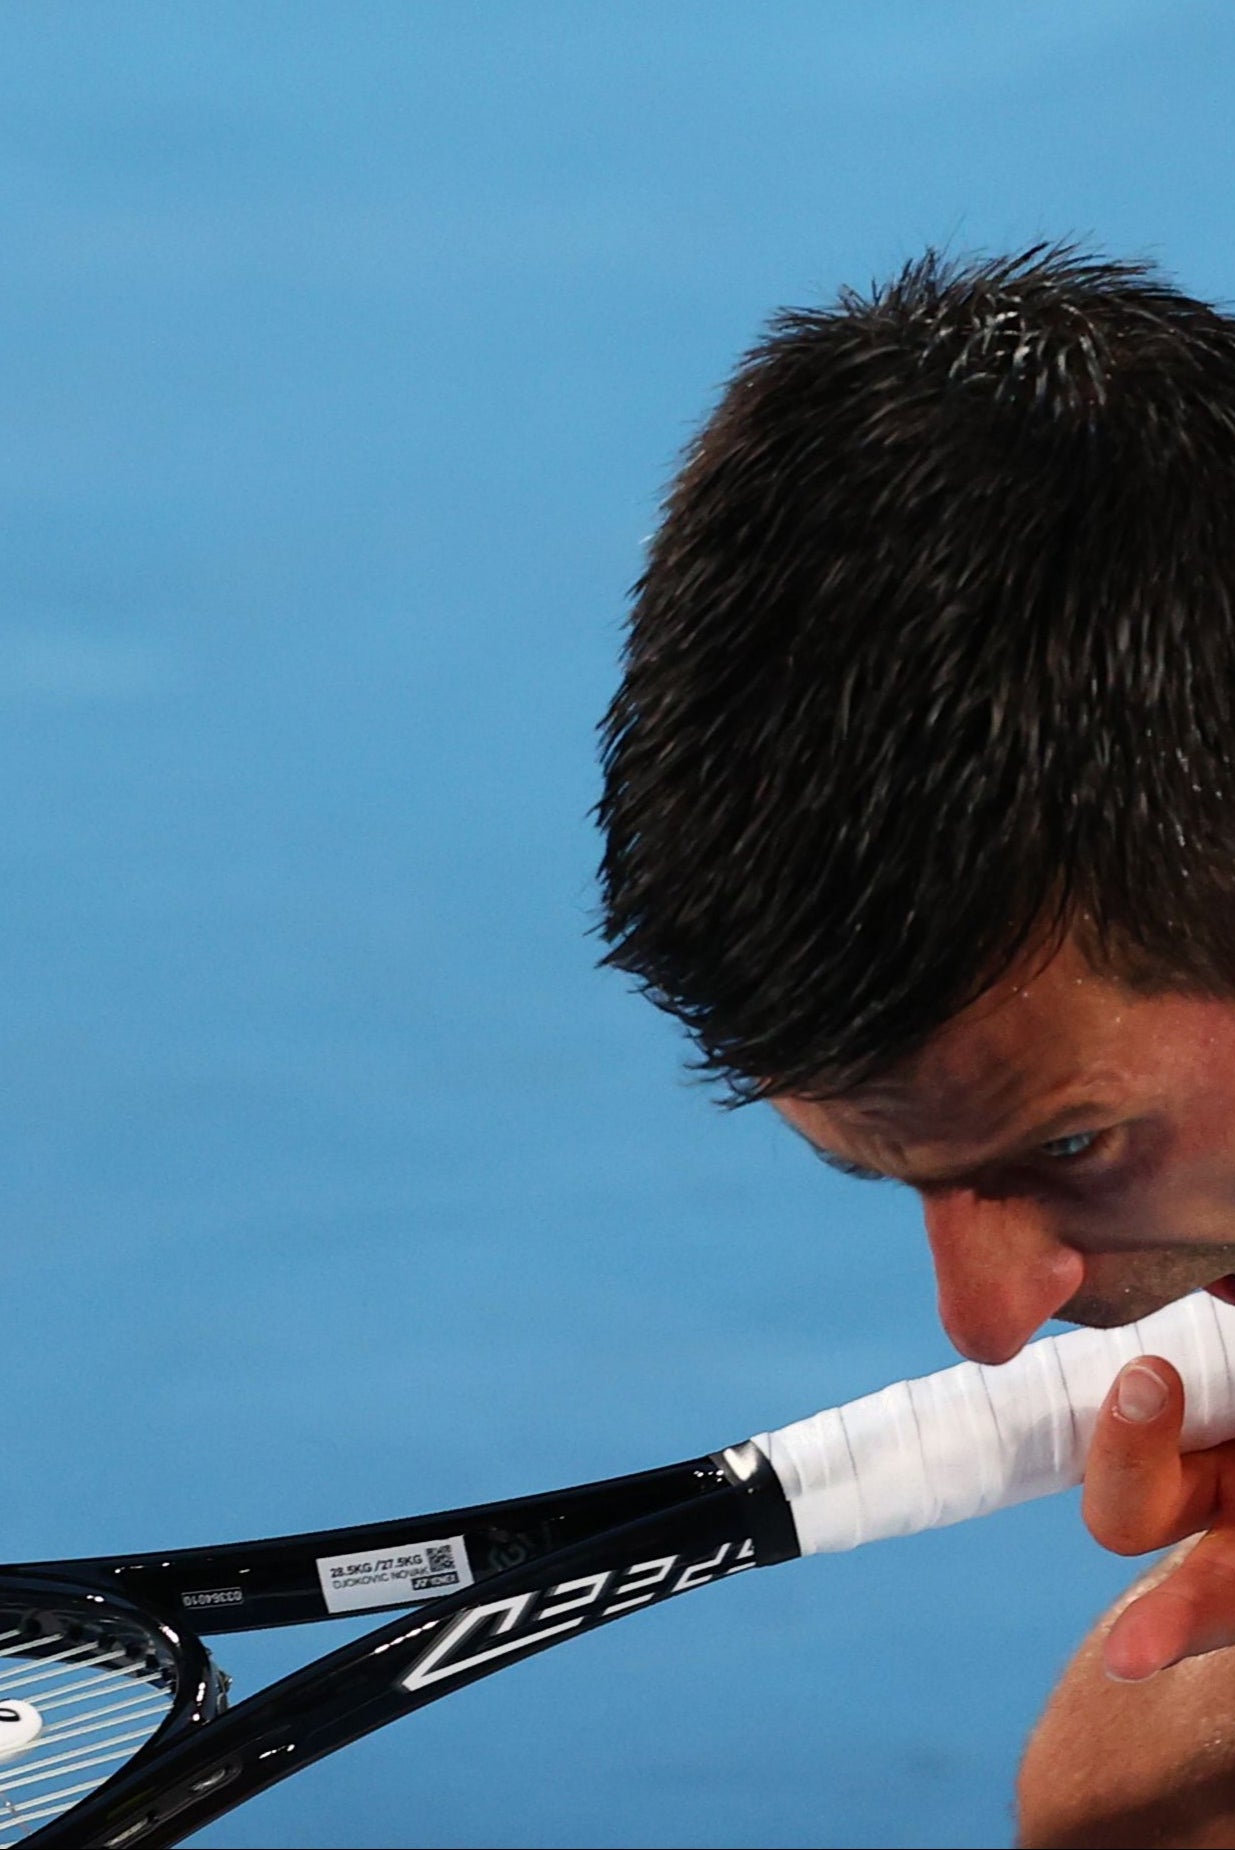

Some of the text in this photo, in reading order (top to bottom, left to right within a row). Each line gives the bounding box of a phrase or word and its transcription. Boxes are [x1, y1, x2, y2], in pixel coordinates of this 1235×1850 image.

[330, 1562, 372, 1578] 28.5KG
[332, 1566, 430, 1589] DJOKOVIC NOVAK
